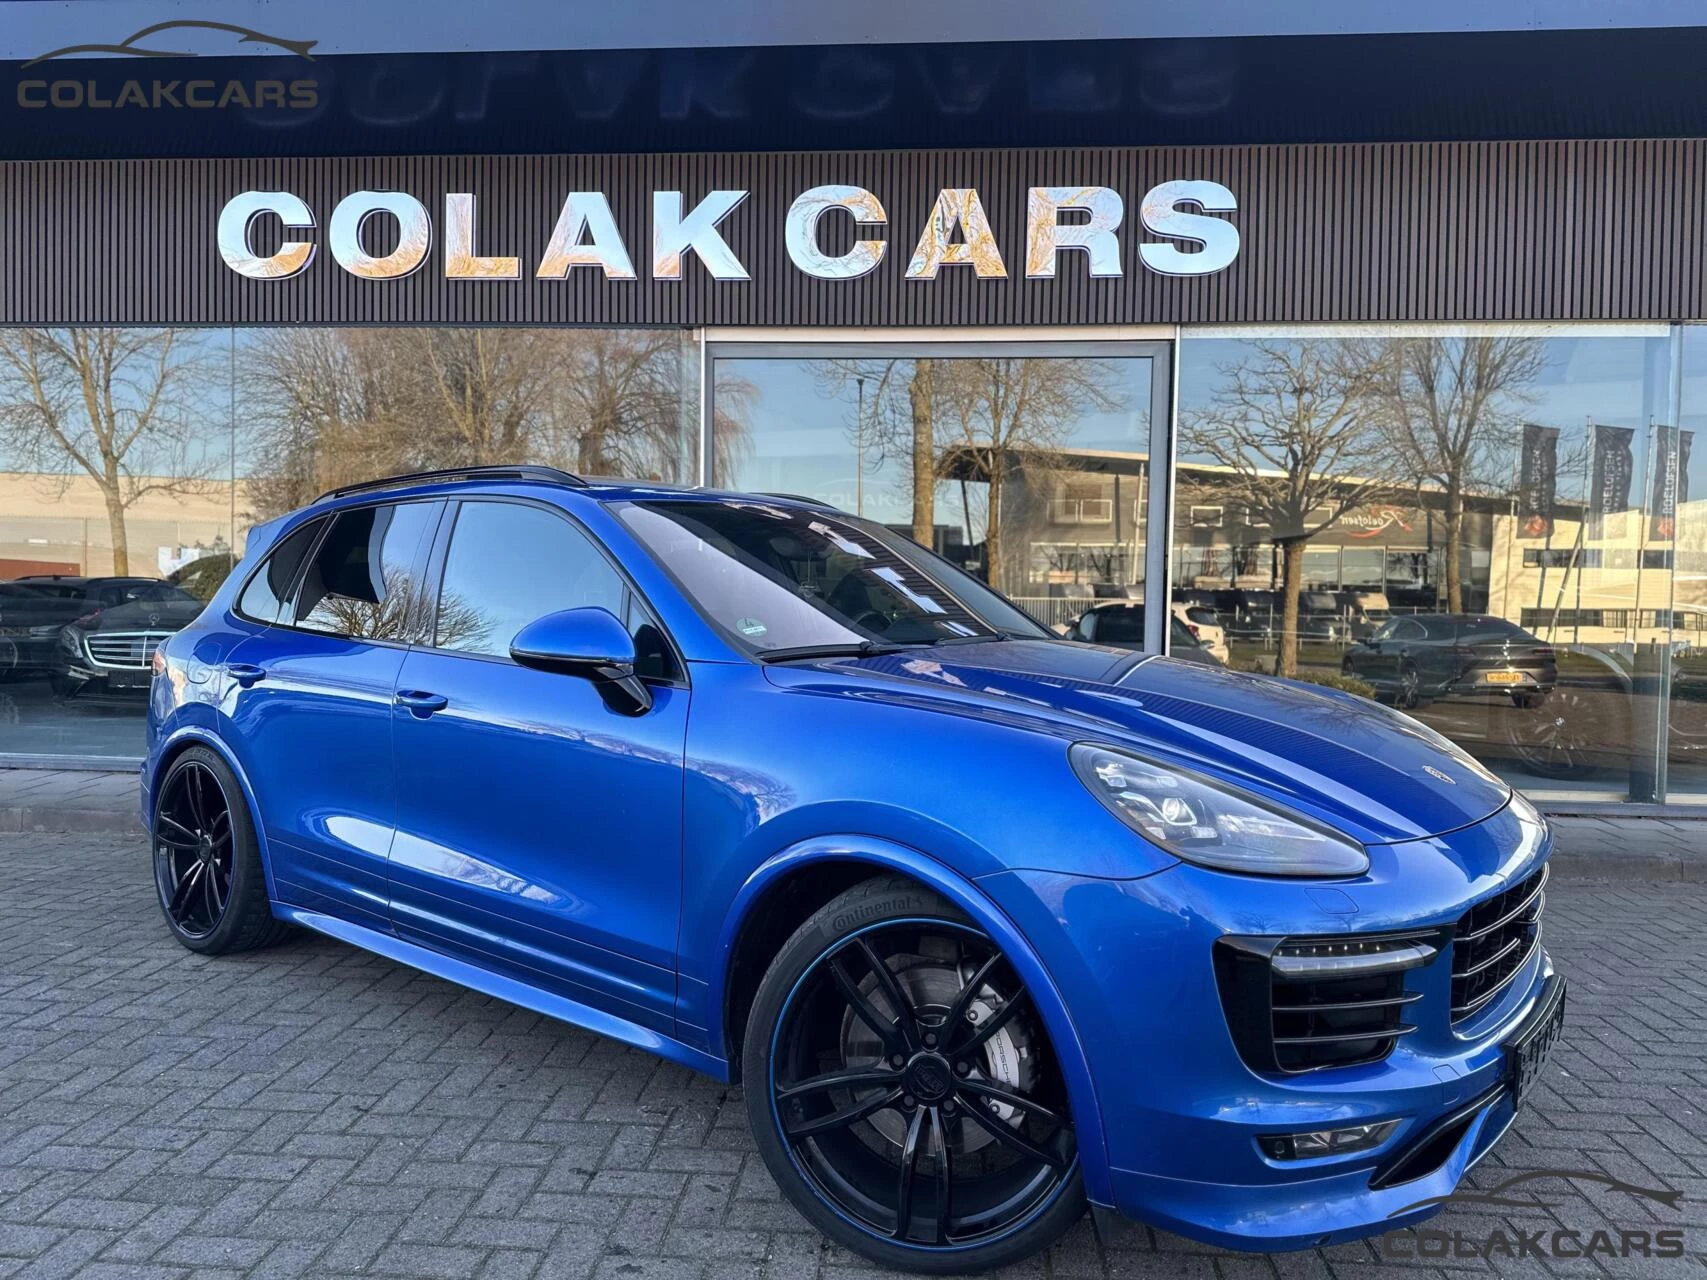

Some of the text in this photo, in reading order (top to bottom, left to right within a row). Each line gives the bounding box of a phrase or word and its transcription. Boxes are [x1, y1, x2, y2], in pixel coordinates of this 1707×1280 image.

[216, 178, 1241, 281] COLAK CARS
[831, 895, 911, 932] Continental
